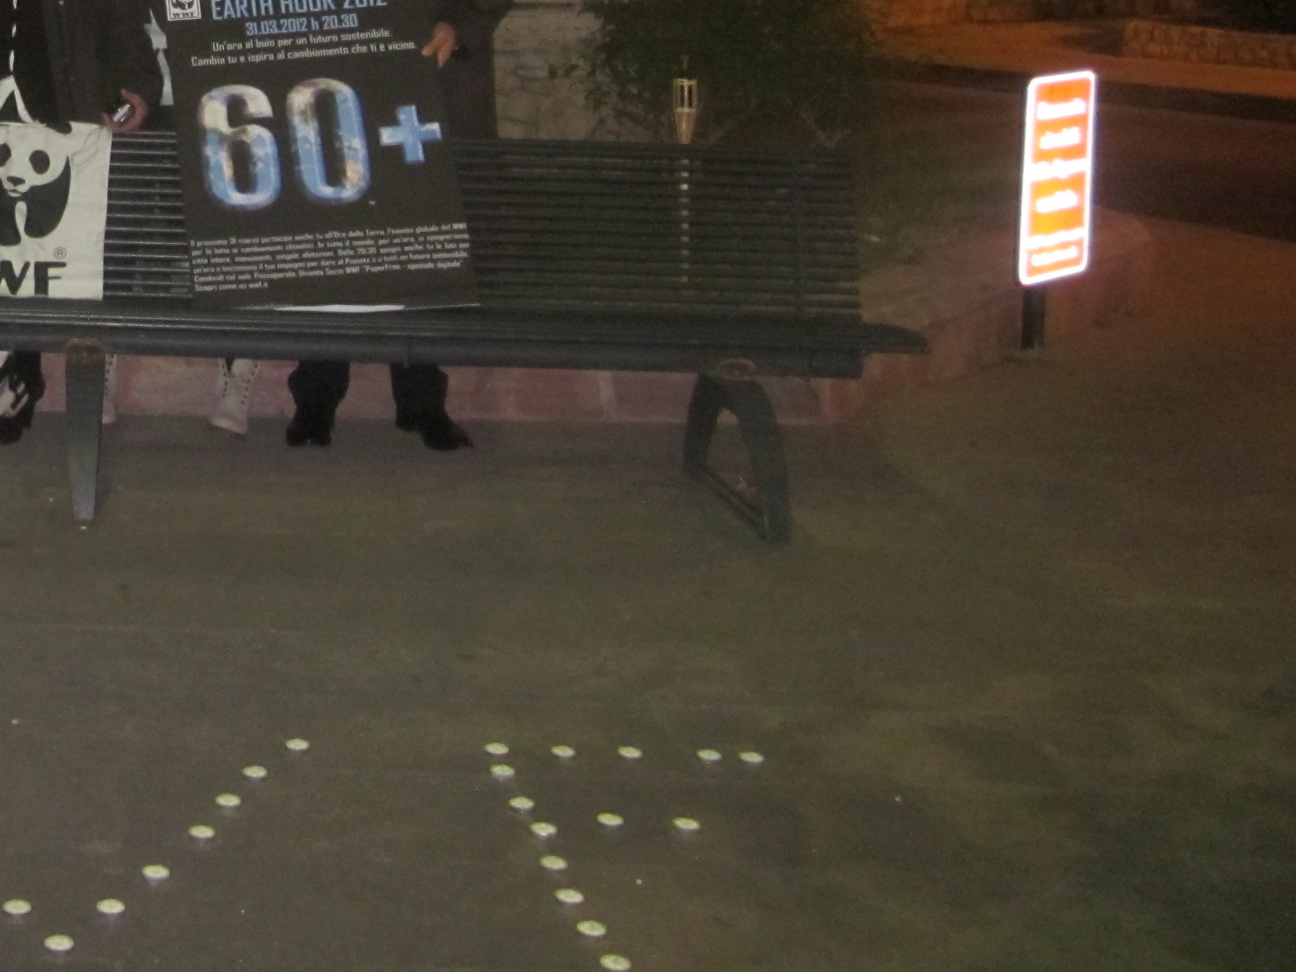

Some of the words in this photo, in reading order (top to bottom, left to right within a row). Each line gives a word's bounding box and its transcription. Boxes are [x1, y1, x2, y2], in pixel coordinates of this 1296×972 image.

[246, 17, 307, 36] 31.03.2012
[311, 16, 319, 30] h
[322, 13, 358, 29] 20.30
[212, 40, 242, 51] Un'ora
[246, 39, 253, 48] al
[255, 38, 274, 48] buio
[277, 38, 293, 48] per
[309, 32, 337, 43] futuro
[341, 27, 392, 41] sostenibile.
[191, 54, 225, 67] Cambia
[228, 55, 236, 63] tu
[240, 55, 245, 63] e
[248, 51, 274, 63] ispira
[277, 50, 284, 59] al
[287, 45, 348, 59] cambiamento
[351, 43, 366, 53] che
[370, 43, 376, 52] ti
[379, 42, 384, 51] è
[388, 40, 417, 51] vicino.
[198, 78, 444, 209] 60+
